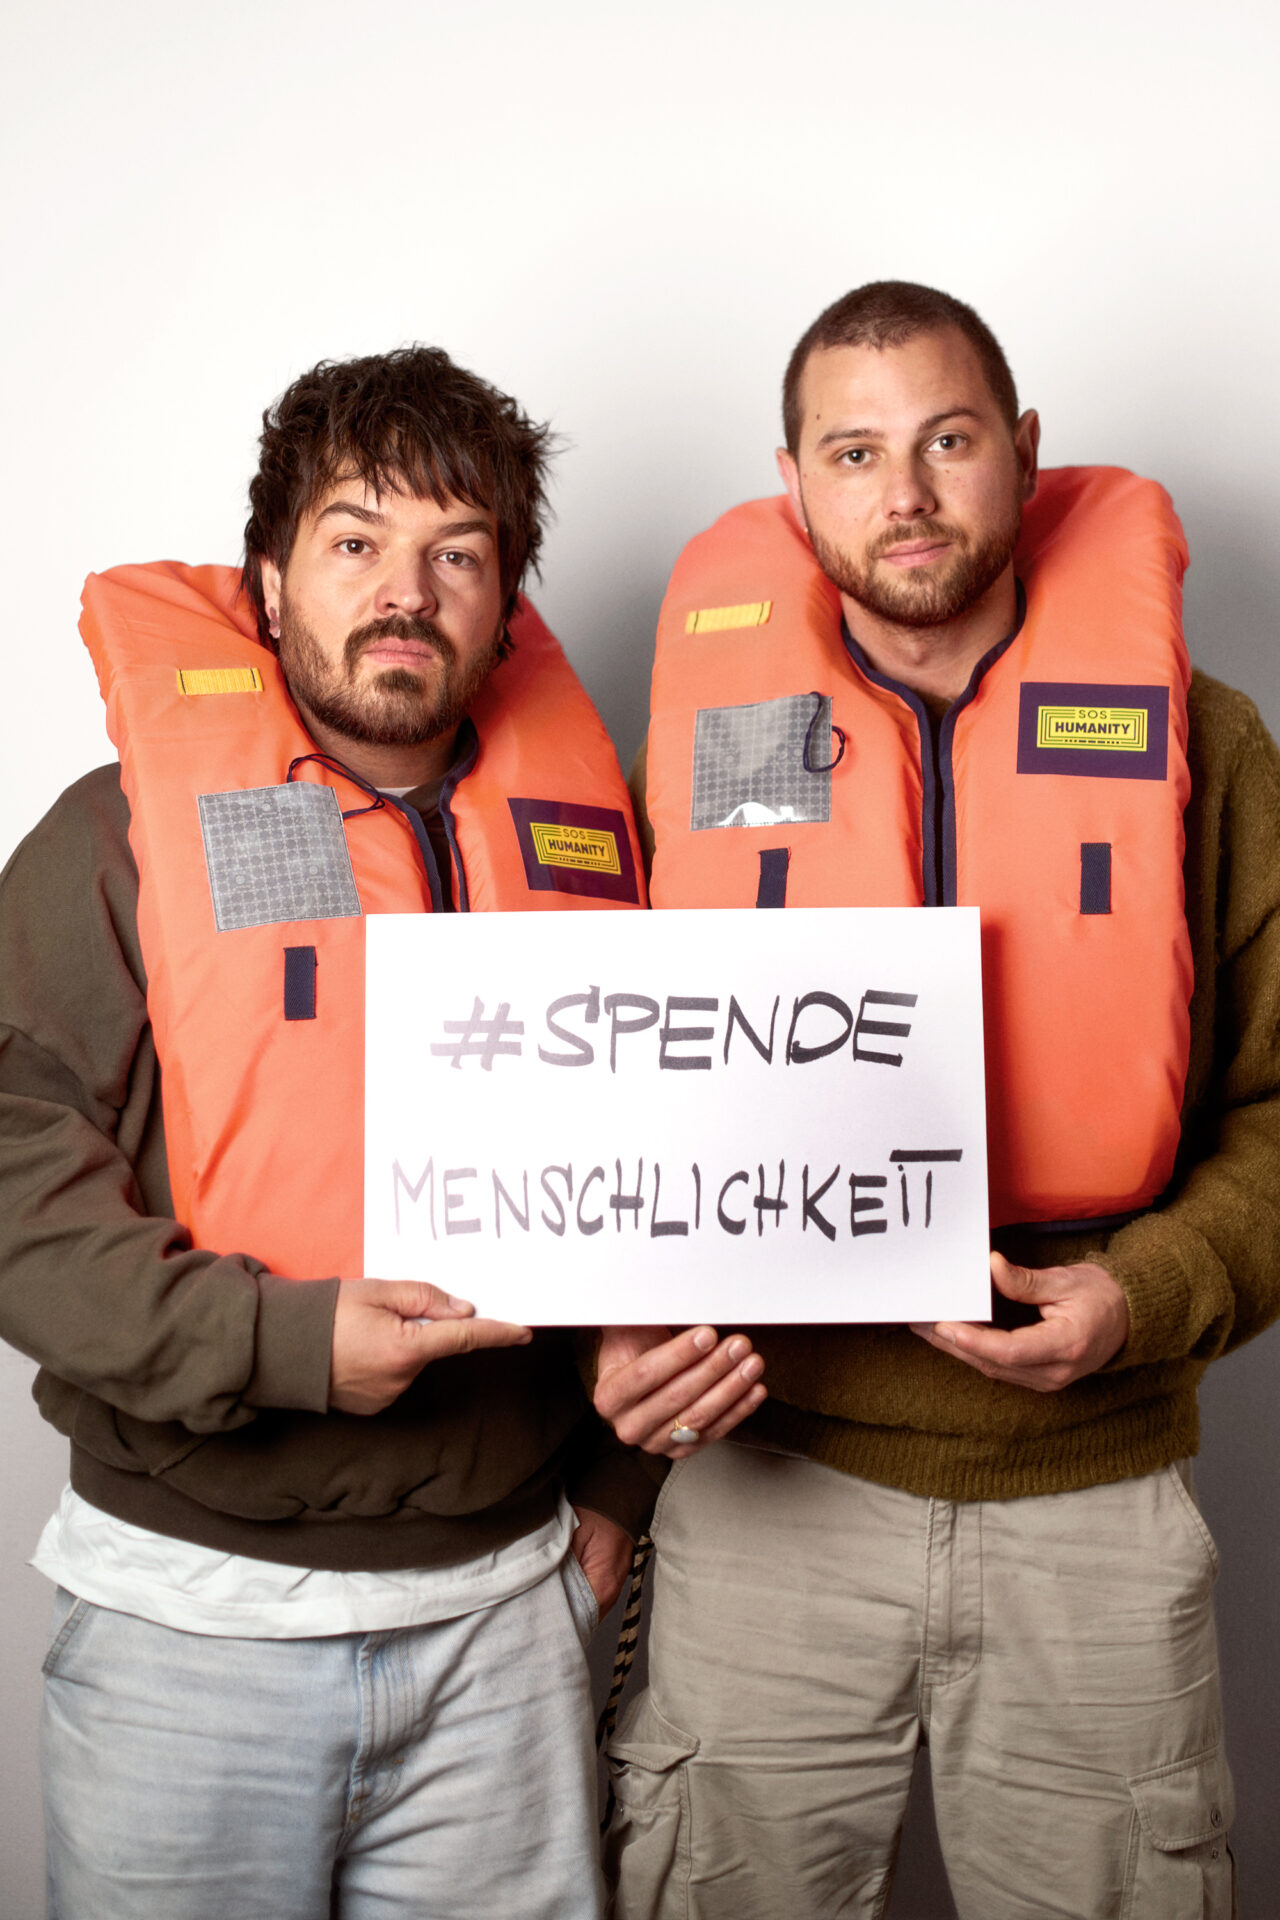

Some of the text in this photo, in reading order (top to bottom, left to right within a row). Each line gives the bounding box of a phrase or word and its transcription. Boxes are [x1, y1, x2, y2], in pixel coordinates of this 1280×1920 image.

[1078, 709, 1108, 719] SOS
[1055, 722, 1131, 734] HUMANITY
[563, 828, 586, 839] SOS
[548, 839, 605, 857] HUMANITY
[430, 985, 919, 1073] #SPENDE
